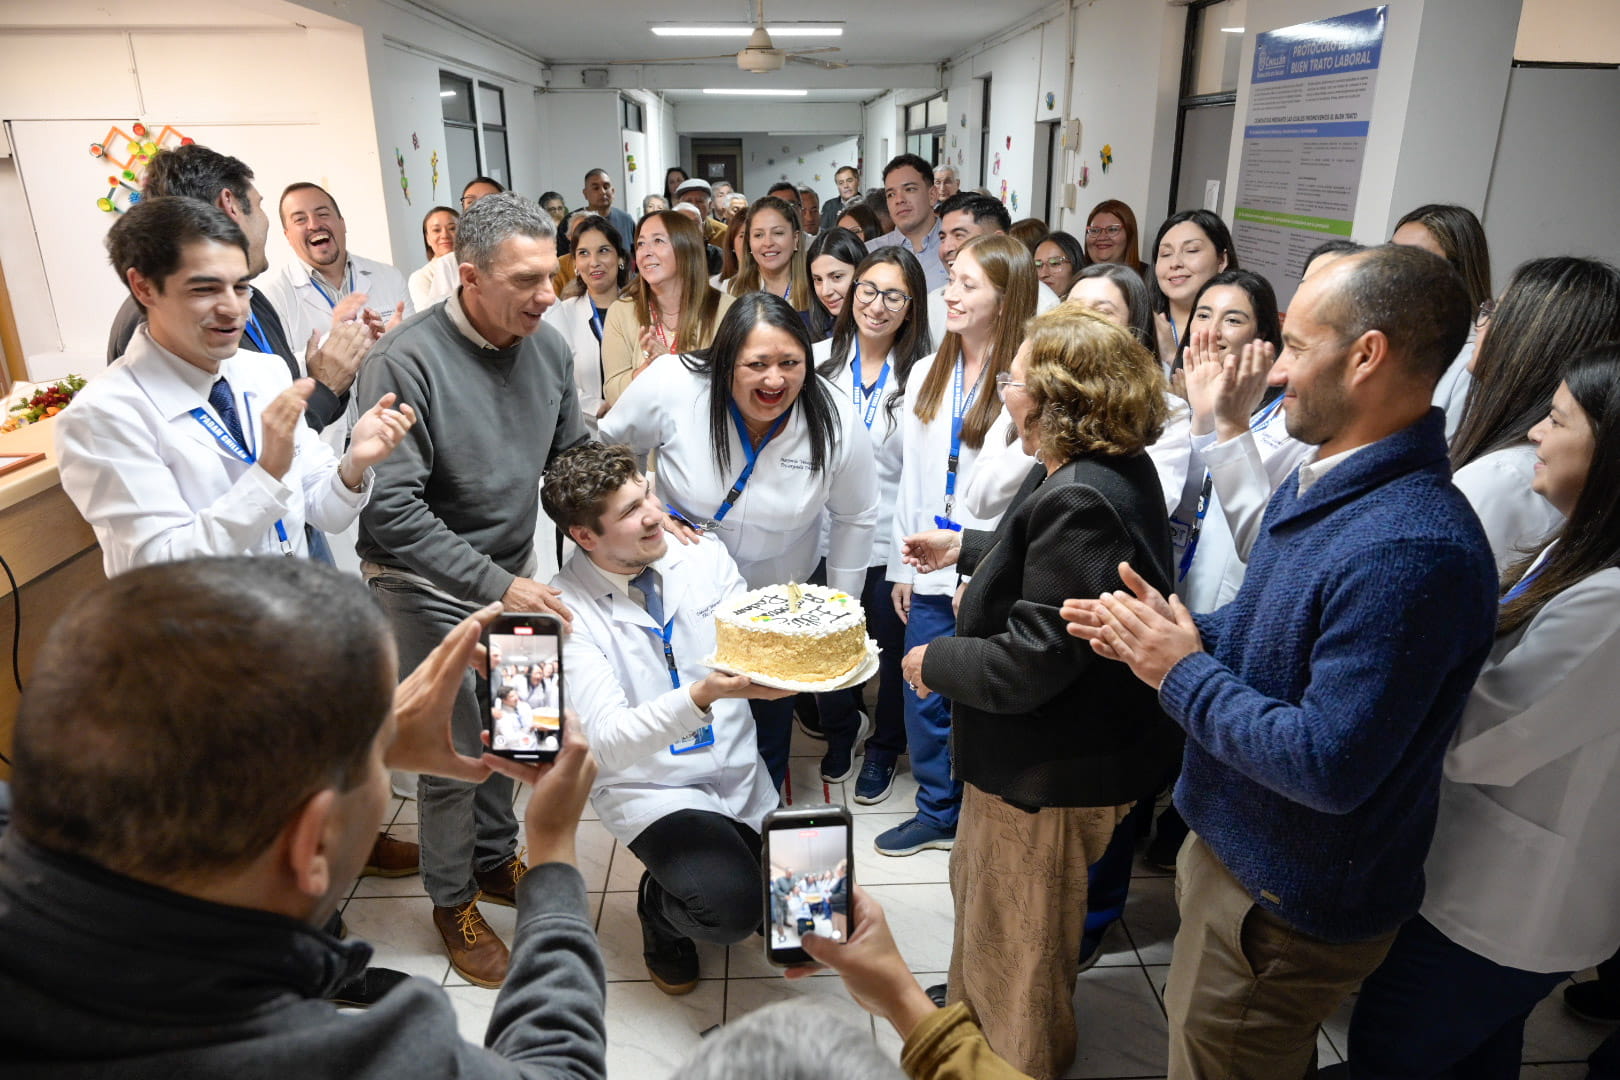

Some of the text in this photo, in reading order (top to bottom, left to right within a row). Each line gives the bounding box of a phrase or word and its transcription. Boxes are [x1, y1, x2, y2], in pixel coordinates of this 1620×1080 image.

[1292, 40, 1336, 57] PROTOCOLO
[1290, 50, 1371, 74] BUEN TRATO LABORAL
[199, 414, 225, 437] PADAM
